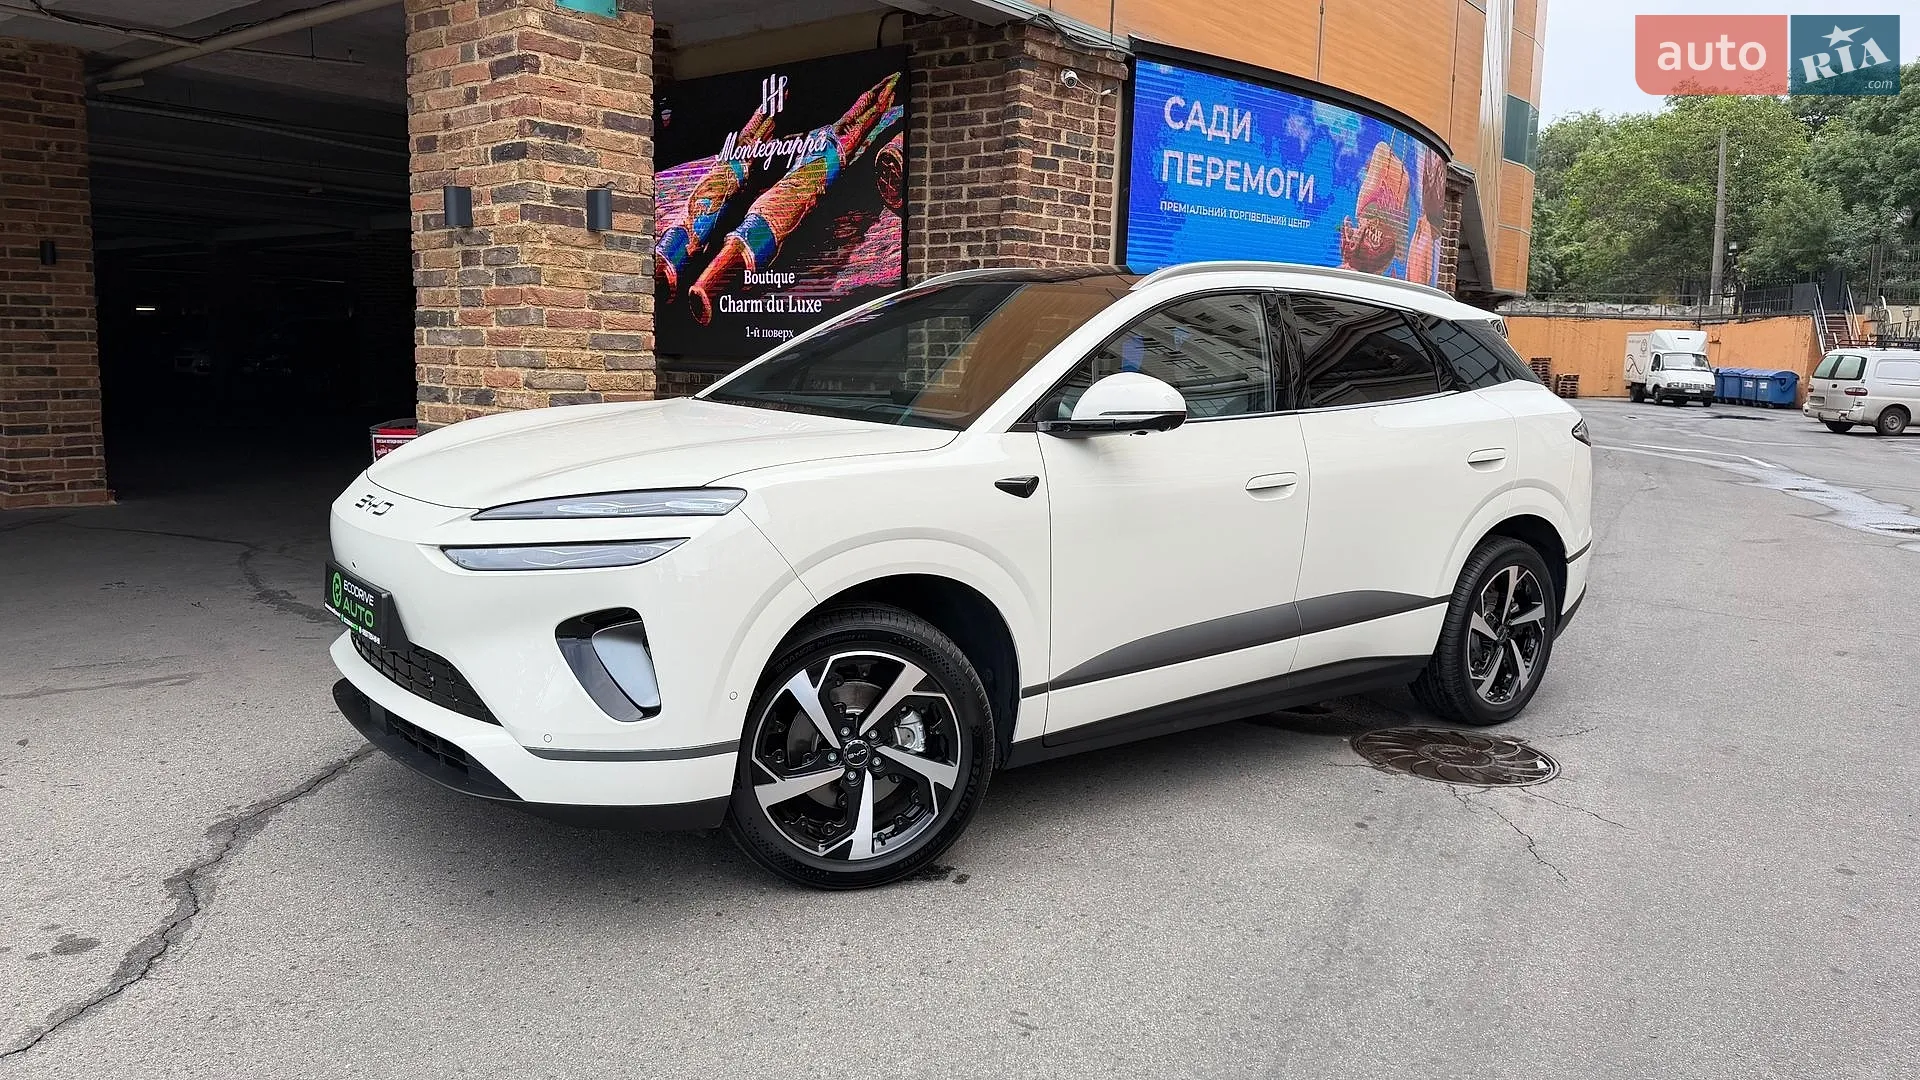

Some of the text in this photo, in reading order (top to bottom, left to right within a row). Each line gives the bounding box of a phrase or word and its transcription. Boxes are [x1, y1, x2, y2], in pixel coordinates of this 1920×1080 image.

[1163, 95, 1252, 144] САДИ
[717, 130, 827, 170] Montegrappa
[1161, 150, 1315, 204] ПЕРЕМОГИ
[1160, 200, 1311, 229] ПРЕМІАЛЬНИЙ ТОРГІВЕЛЬНИЙ ЦЕНТР
[744, 270, 795, 288] Boutique
[719, 295, 822, 313] Charm du Luxe
[745, 326, 794, 341] 1-й поверх
[343, 579, 375, 607] ECODRIVE
[343, 597, 374, 628] AUTO
